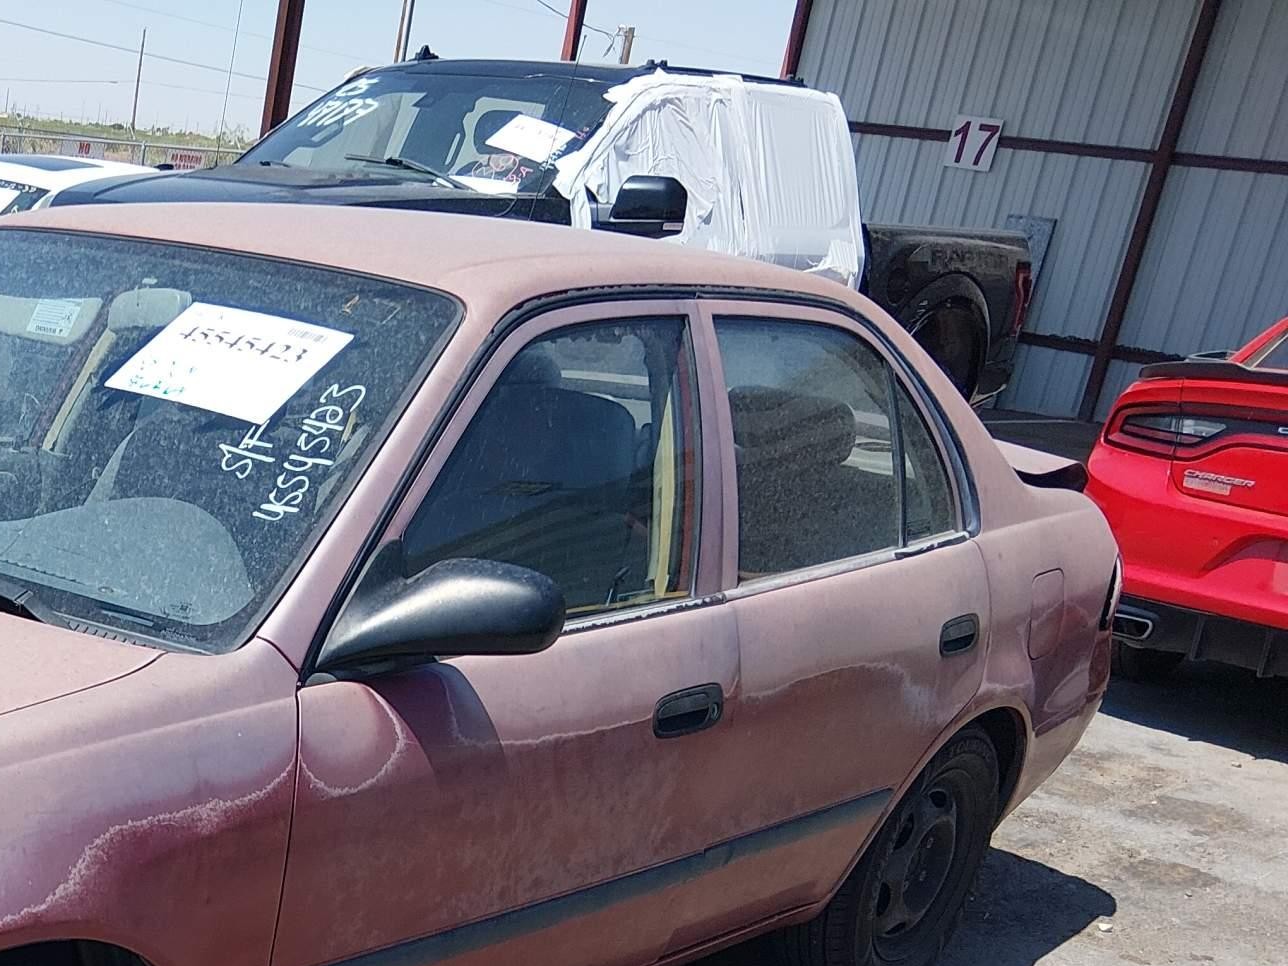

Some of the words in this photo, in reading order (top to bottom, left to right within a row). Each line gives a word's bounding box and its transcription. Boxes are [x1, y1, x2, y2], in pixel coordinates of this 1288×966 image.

[953, 121, 1000, 166] 17
[180, 326, 308, 362] 45545423
[252, 383, 366, 520] 45545423
[1184, 468, 1256, 488] CHARGER
